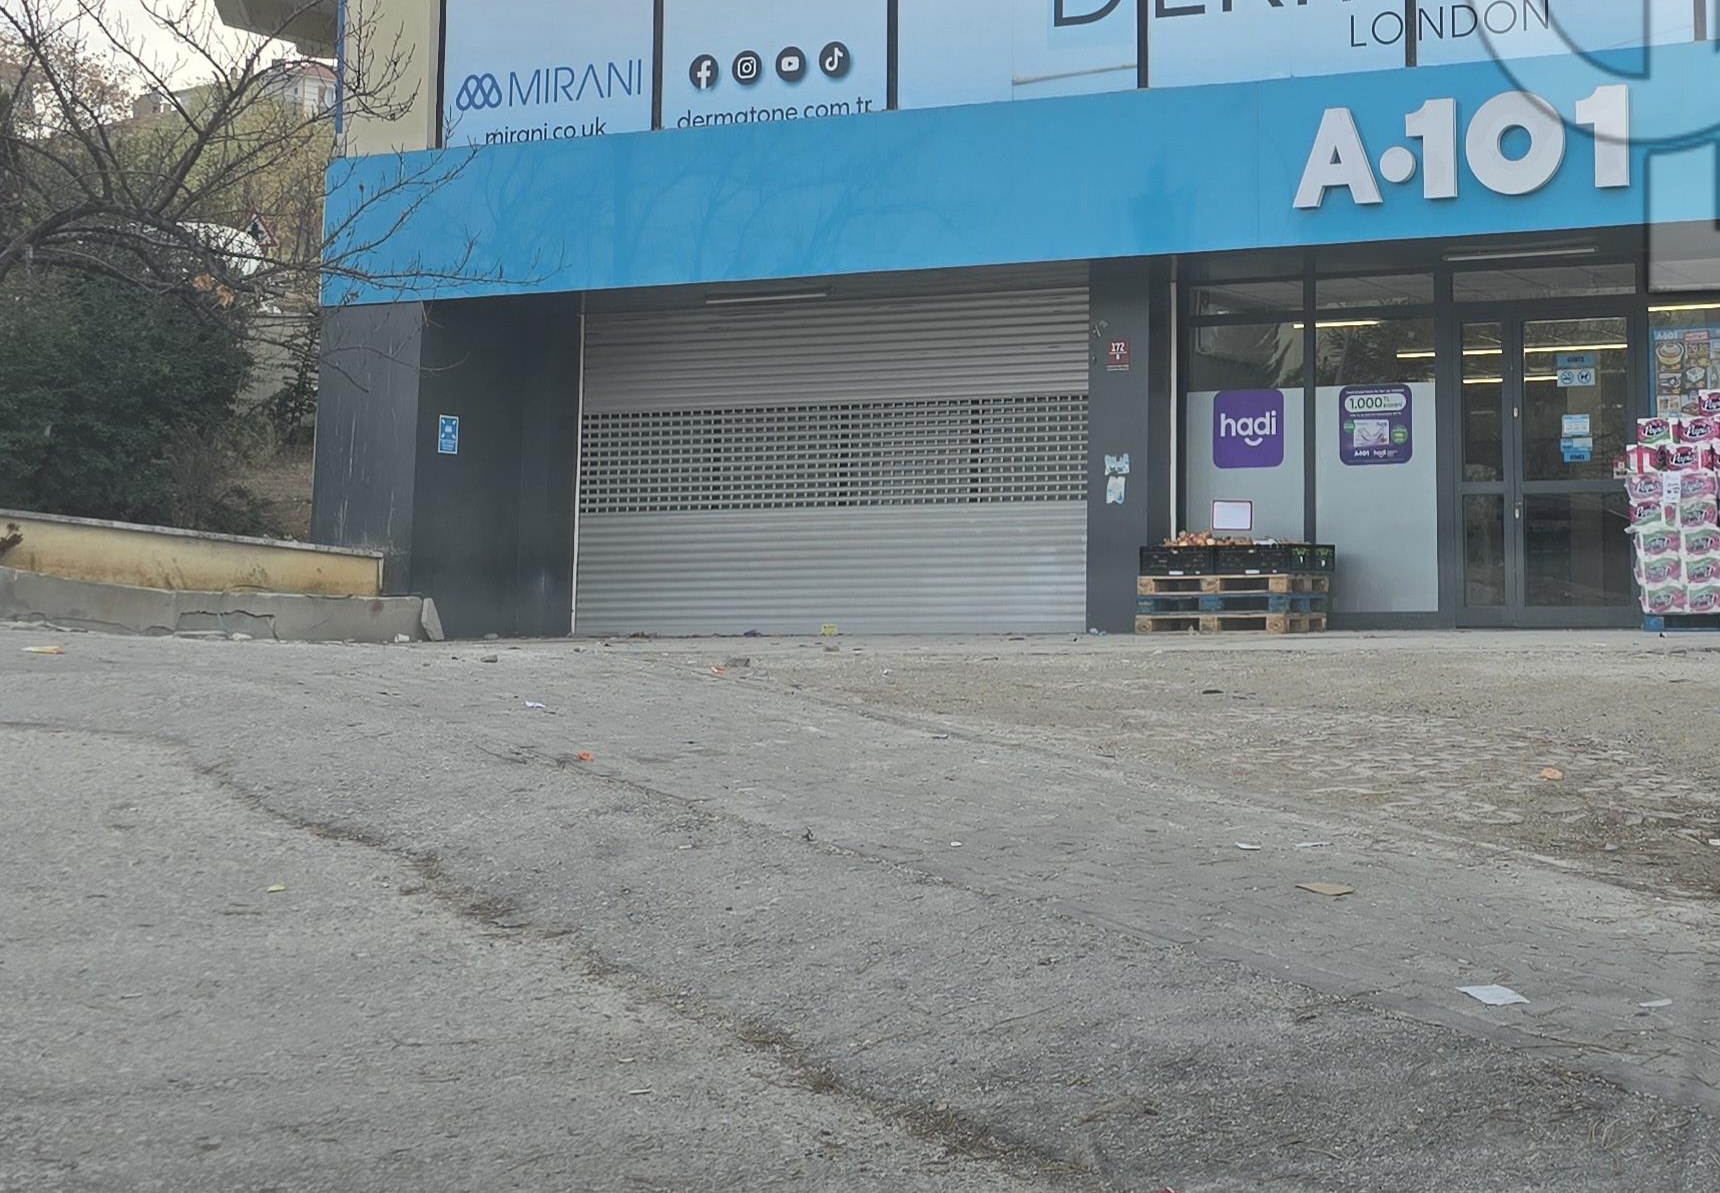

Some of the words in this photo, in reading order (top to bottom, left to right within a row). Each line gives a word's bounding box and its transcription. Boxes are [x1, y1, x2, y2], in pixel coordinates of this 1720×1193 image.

[508, 59, 642, 107] MIRANI
[677, 96, 873, 129] dermatonecomtr
[484, 116, 607, 145] miranicouk
[1110, 342, 1126, 352] 172
[1350, 396, 1383, 409] 1.000
[1220, 409, 1277, 437] hadi
